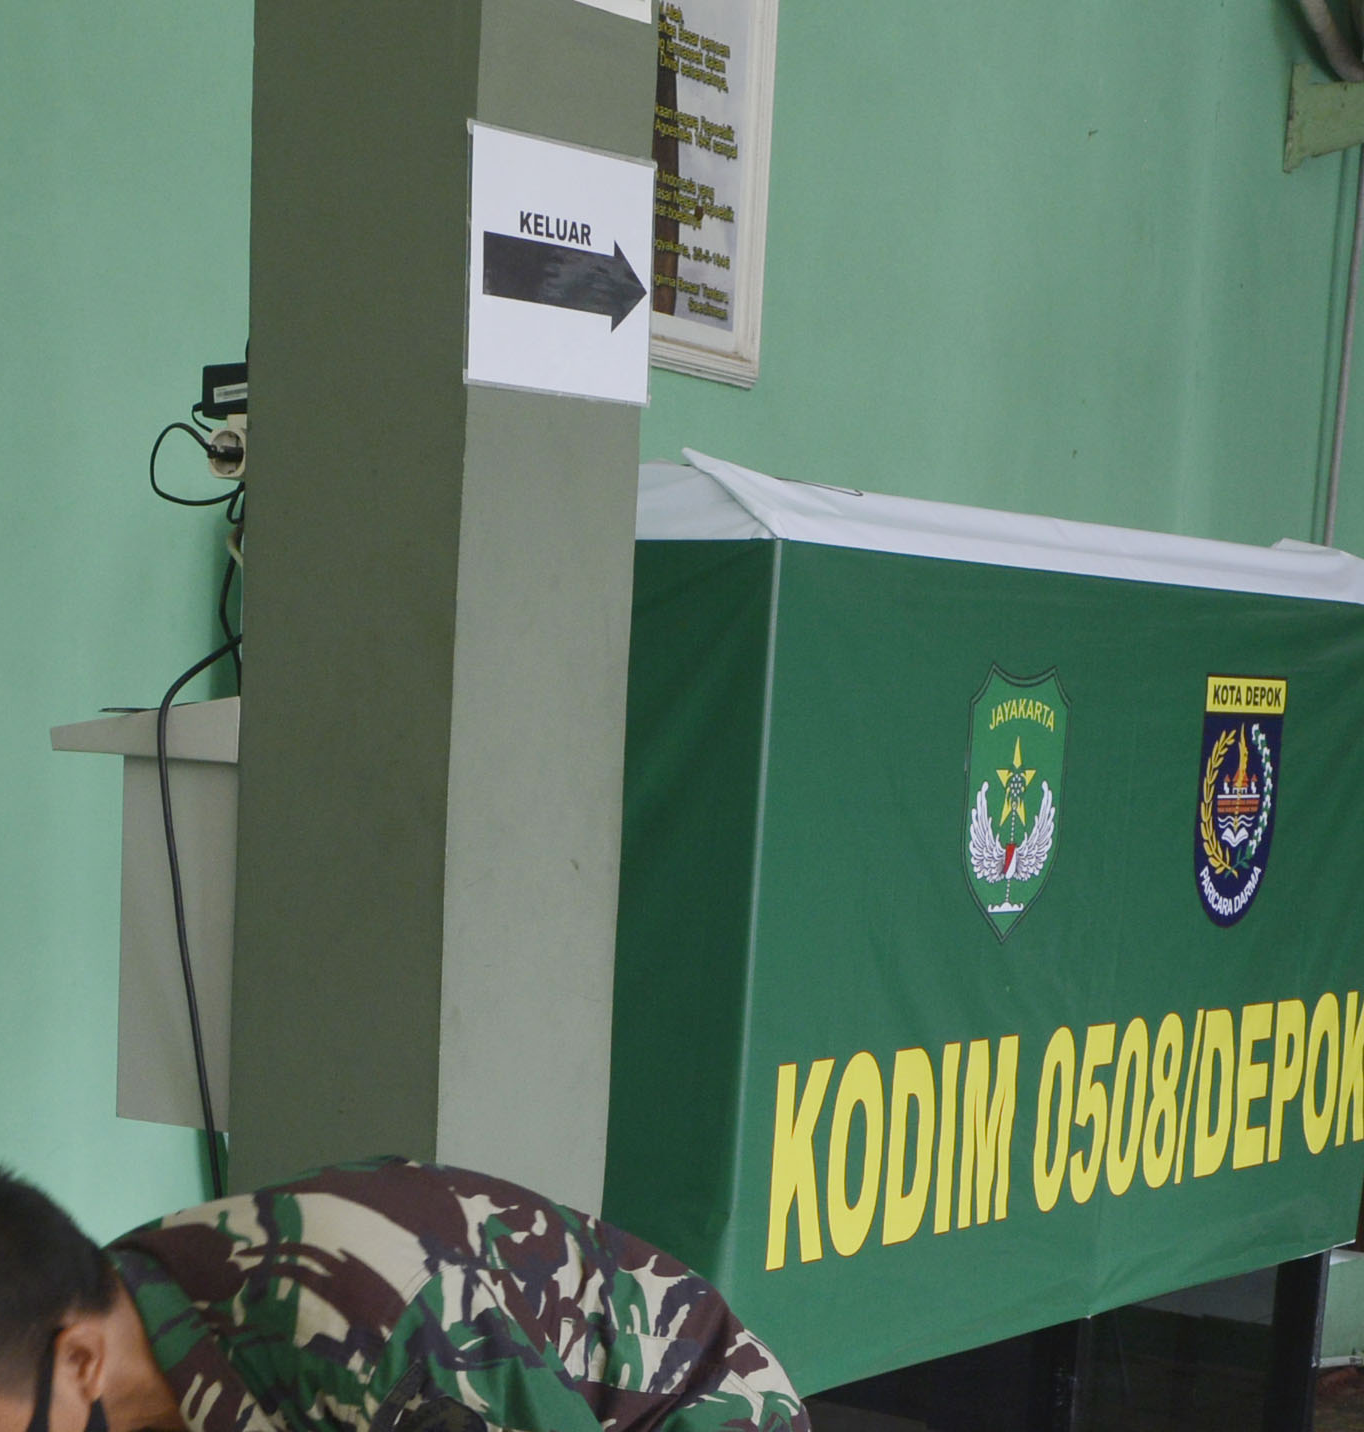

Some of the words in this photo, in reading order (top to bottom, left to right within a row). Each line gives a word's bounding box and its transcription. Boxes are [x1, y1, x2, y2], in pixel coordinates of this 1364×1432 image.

[519, 210, 592, 247] KELUAR
[1212, 683, 1243, 707] KOTA
[1245, 686, 1282, 709] DEPOK
[988, 697, 1056, 733] JAYAKARTA
[1199, 864, 1233, 918] PARICARA
[1234, 865, 1263, 914] DARMA
[765, 1034, 1020, 1272] KODIM
